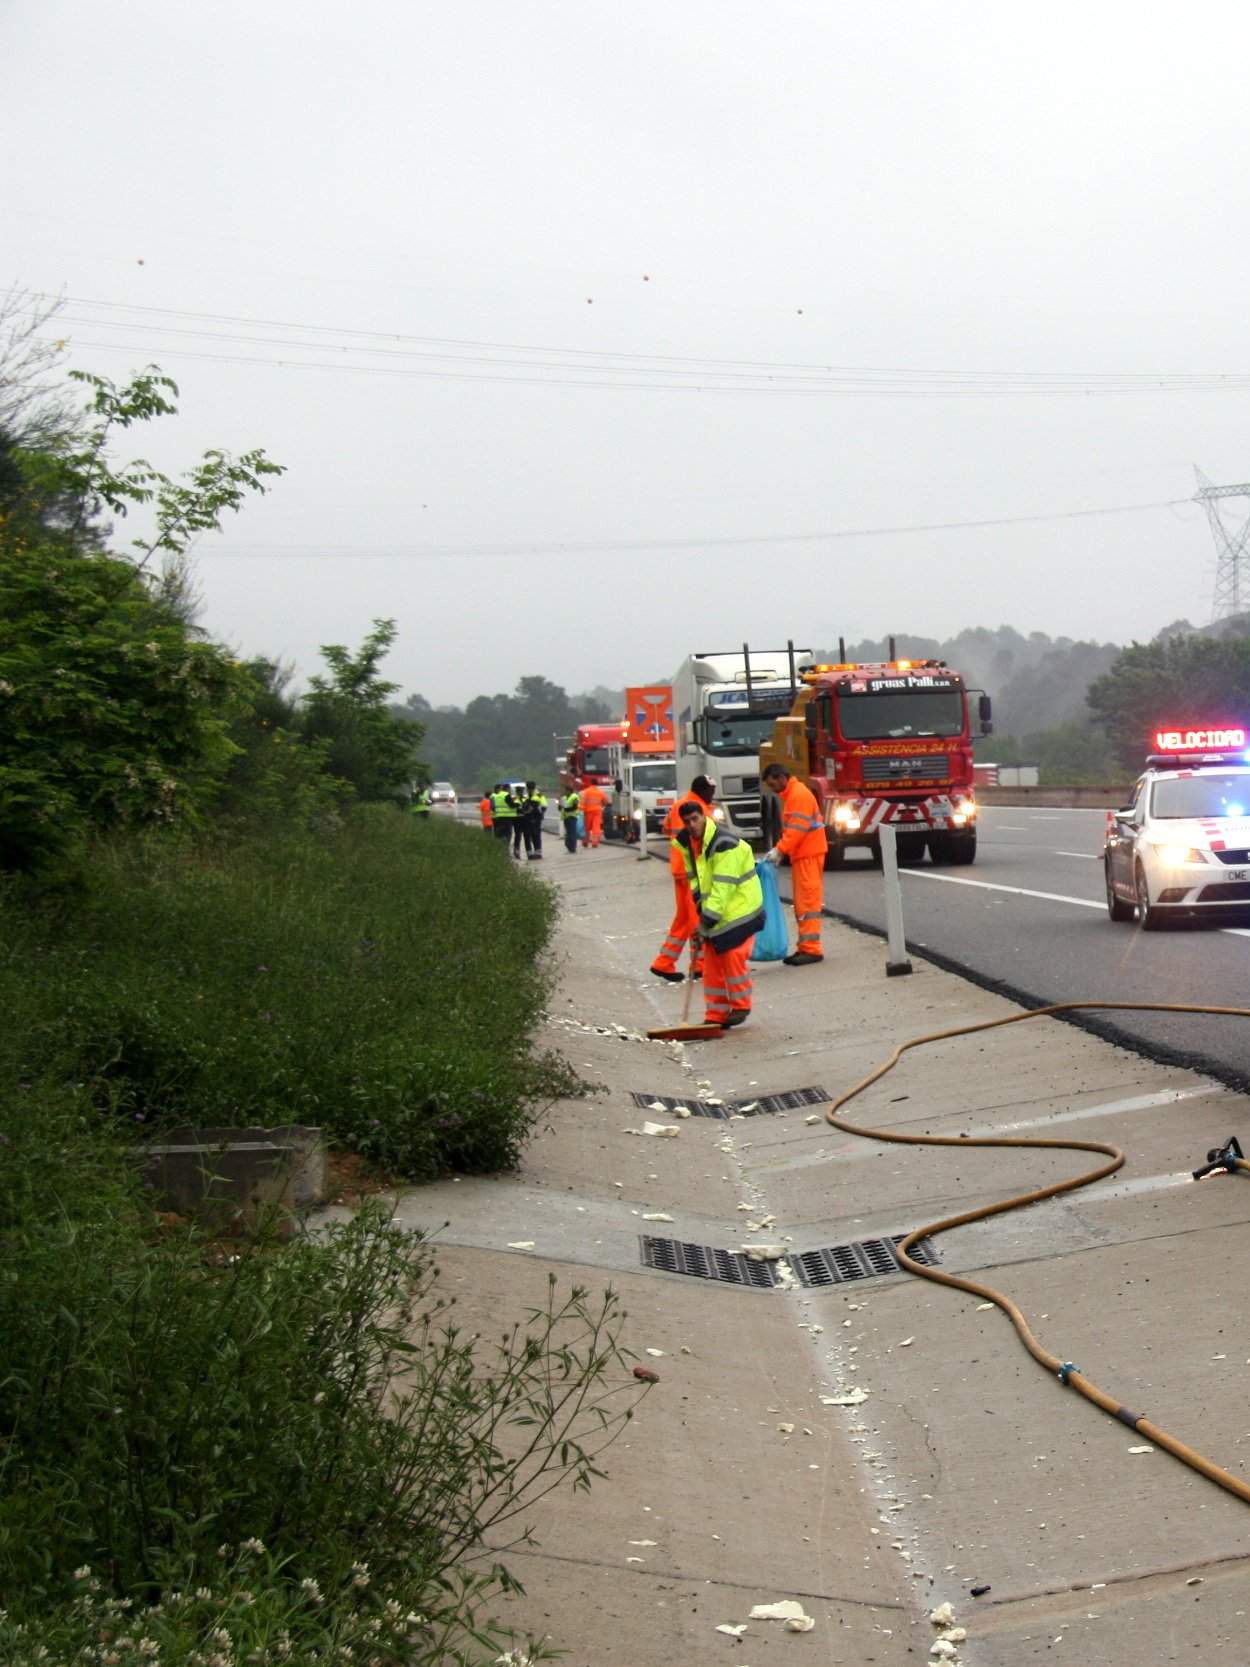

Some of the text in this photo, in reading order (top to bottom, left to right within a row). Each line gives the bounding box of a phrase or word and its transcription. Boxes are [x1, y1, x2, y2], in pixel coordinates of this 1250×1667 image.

[1157, 730, 1245, 749] VELOCIDAD
[889, 760, 922, 769] MAN
[1228, 871, 1247, 881] CME
